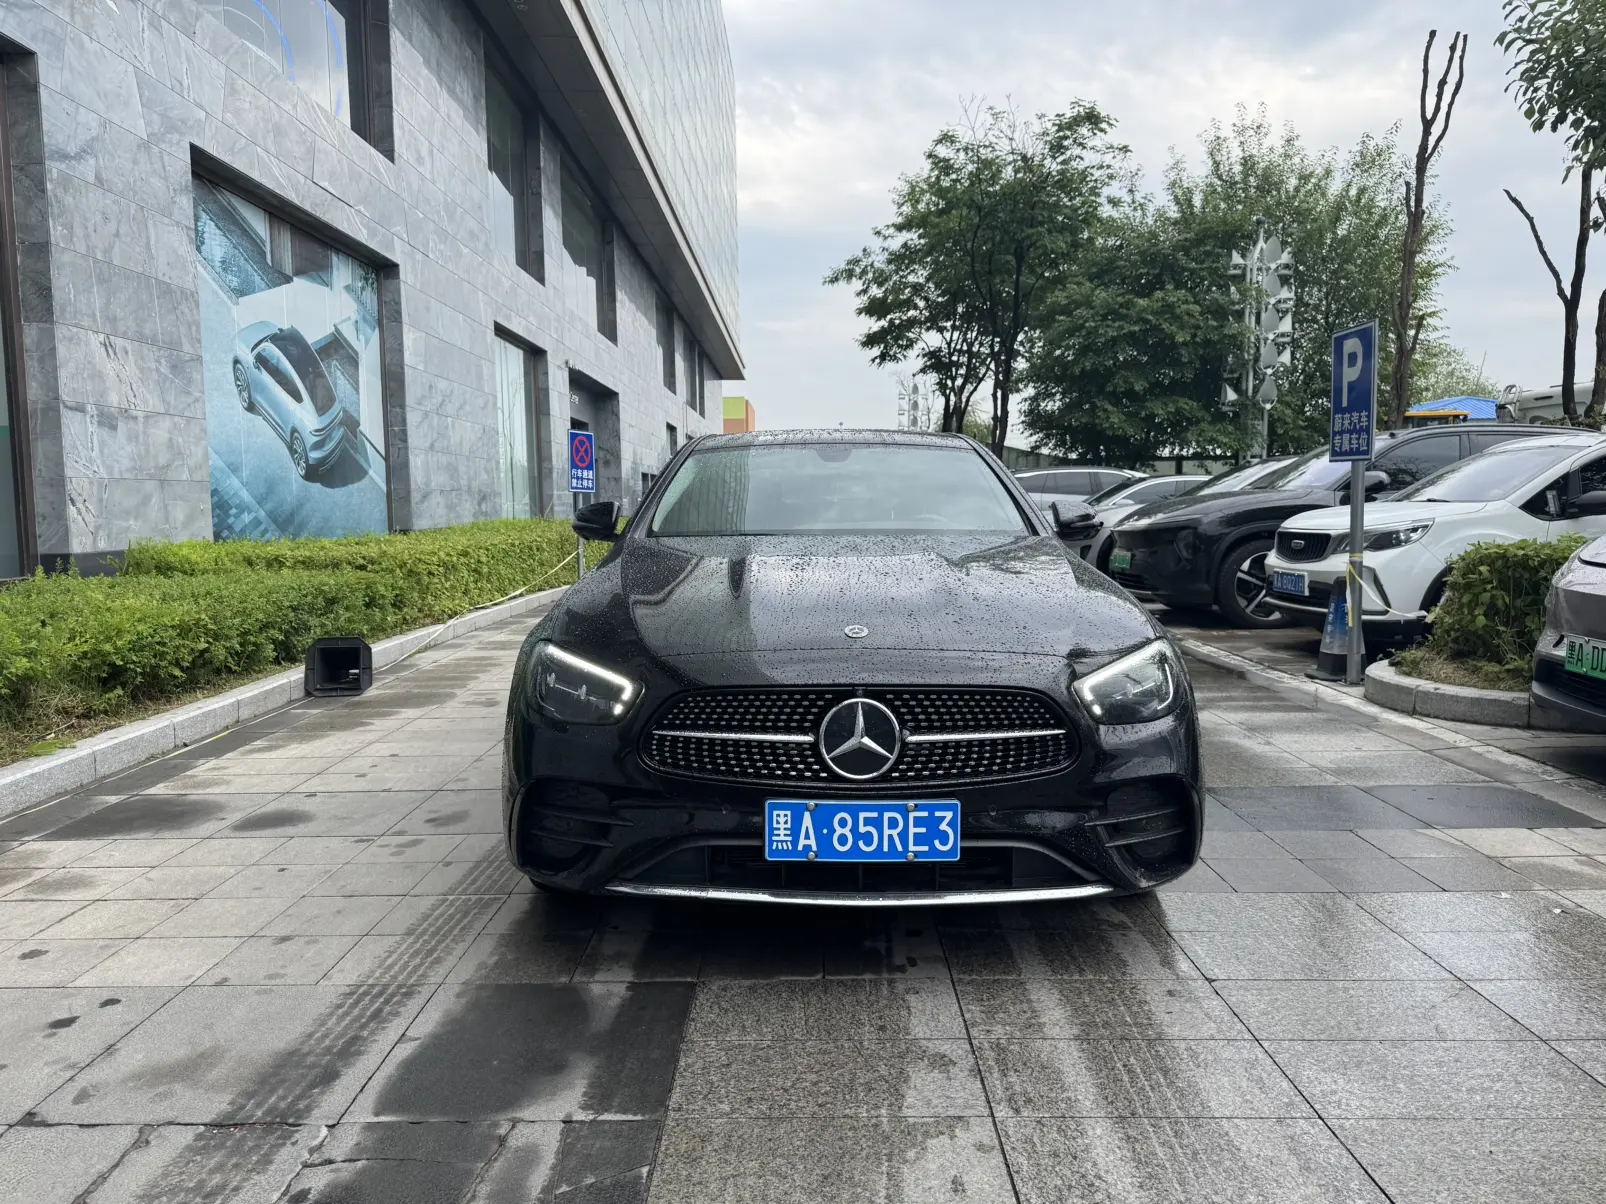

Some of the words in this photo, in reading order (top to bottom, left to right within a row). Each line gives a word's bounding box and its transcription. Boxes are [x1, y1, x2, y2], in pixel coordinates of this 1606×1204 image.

[1342, 337, 1363, 407] P
[1334, 410, 1368, 431] 蔚来汽车
[1333, 432, 1368, 452] 专属车位
[571, 468, 593, 479] 行车通道
[571, 478, 593, 488] 禁止停车
[771, 810, 955, 852] 黑A·85RE3
